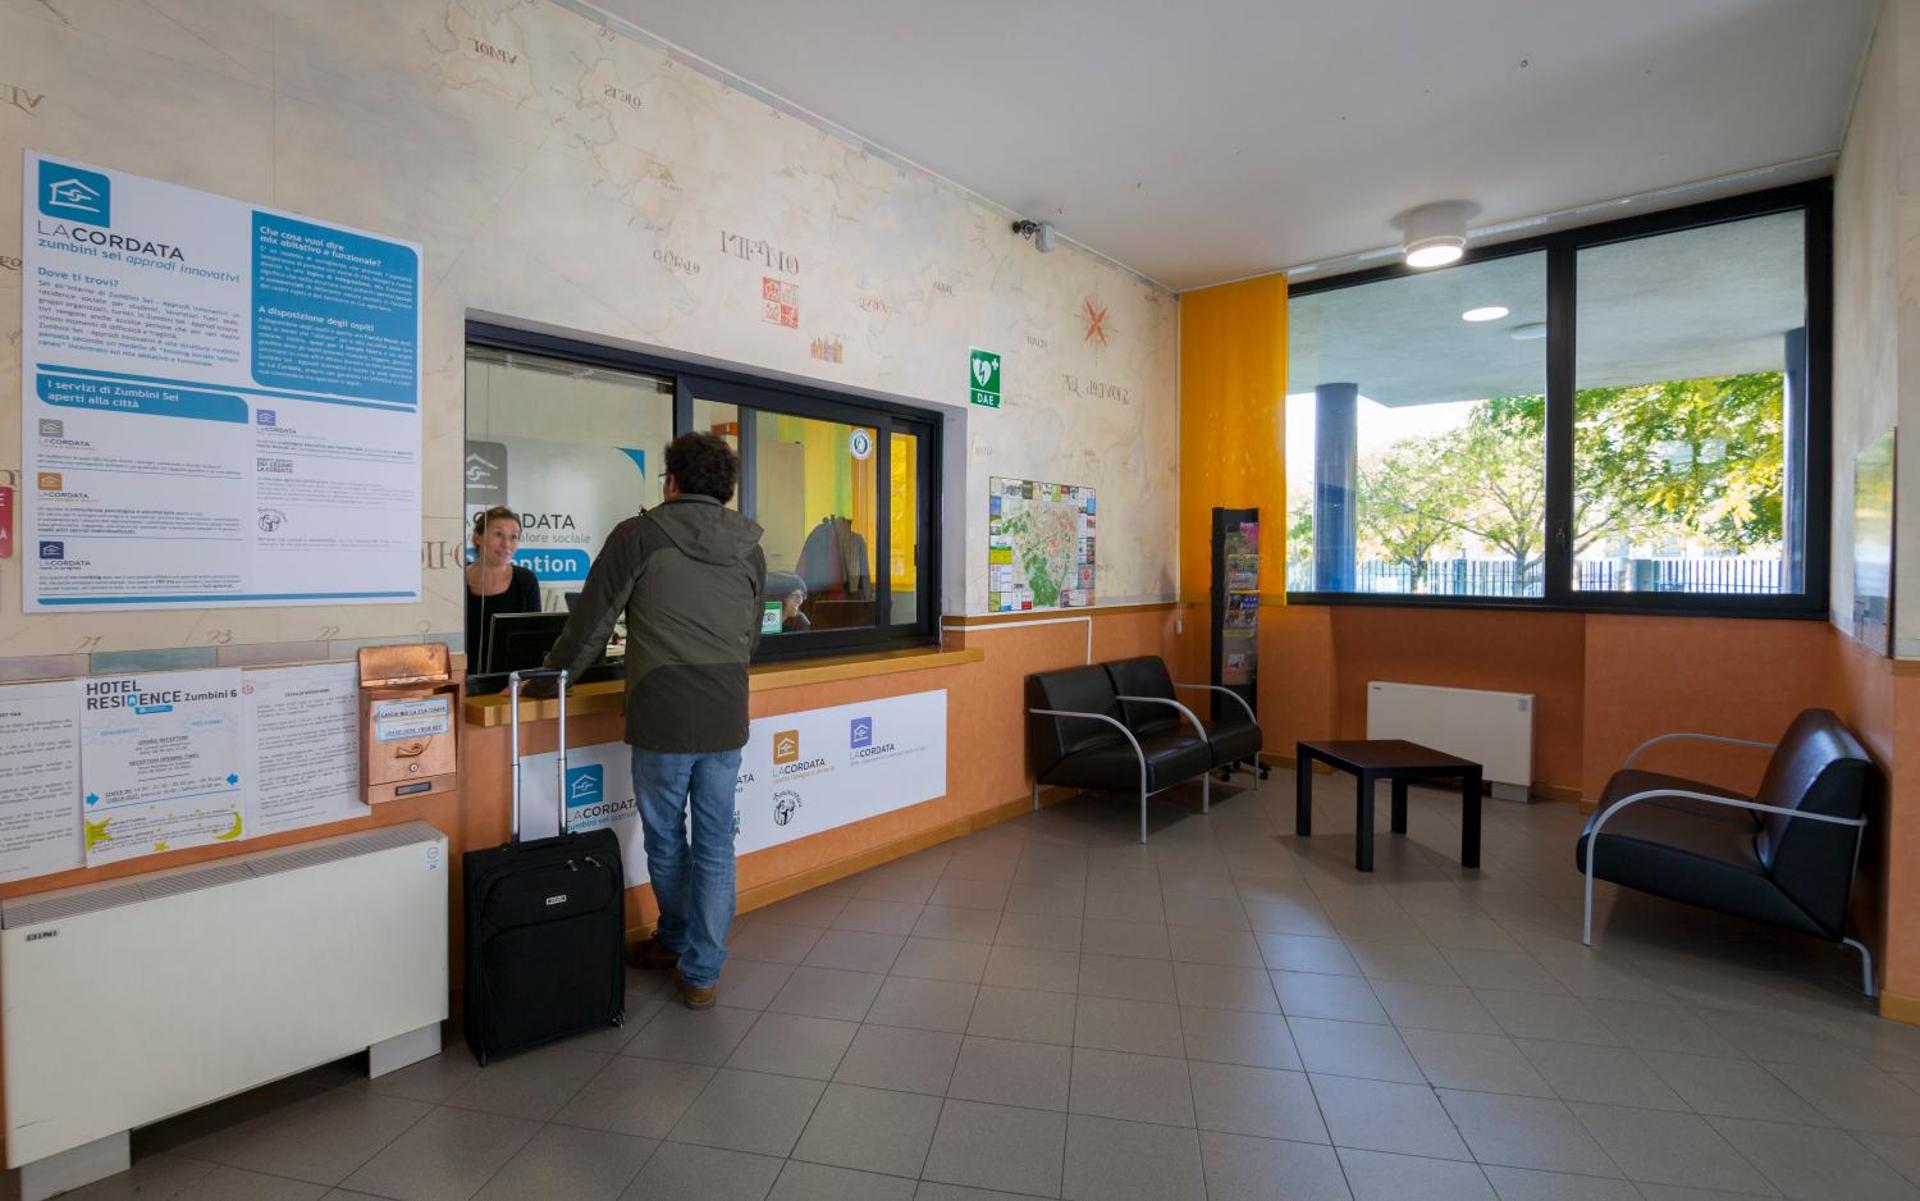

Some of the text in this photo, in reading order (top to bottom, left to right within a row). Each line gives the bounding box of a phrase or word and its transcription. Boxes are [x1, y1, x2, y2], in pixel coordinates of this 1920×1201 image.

[38, 219, 185, 262] LACORDATA
[260, 226, 345, 251] Che cosa vuol dire
[260, 235, 278, 245] mix
[281, 239, 321, 255] abitativo
[39, 238, 240, 284] zumbini sei approdi innovativi
[38, 266, 119, 289] Dove ti trovi?
[258, 306, 266, 314] A
[328, 317, 348, 329] degli
[48, 393, 140, 409] aperti alla città
[55, 381, 95, 393] servizi
[100, 385, 111, 395] di
[114, 387, 159, 400] Zumbini
[163, 392, 179, 402] Sei
[977, 392, 995, 406] DAE
[86, 680, 142, 696] HOTEL
[184, 692, 228, 702] Zumbini
[230, 689, 238, 698] 6
[773, 758, 826, 778] LACORDATA
